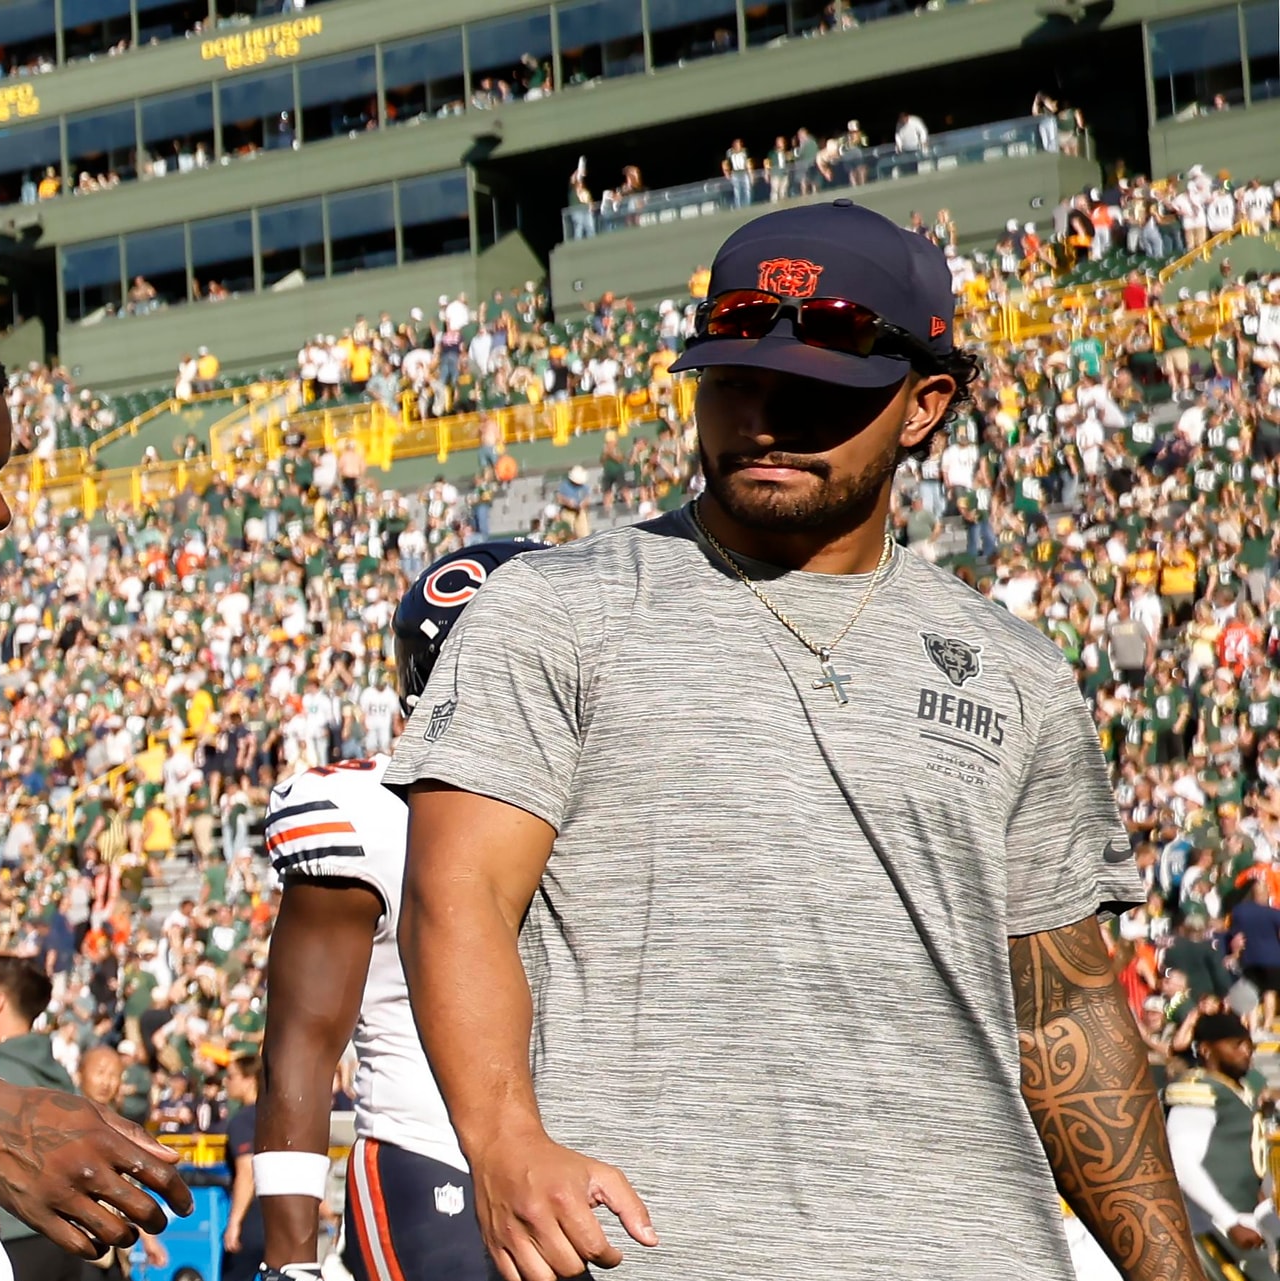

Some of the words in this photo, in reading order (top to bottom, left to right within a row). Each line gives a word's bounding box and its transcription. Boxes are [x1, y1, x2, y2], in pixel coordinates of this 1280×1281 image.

[202, 33, 242, 60] DON
[244, 15, 321, 49] HUTSON
[918, 688, 1007, 746] BEARS
